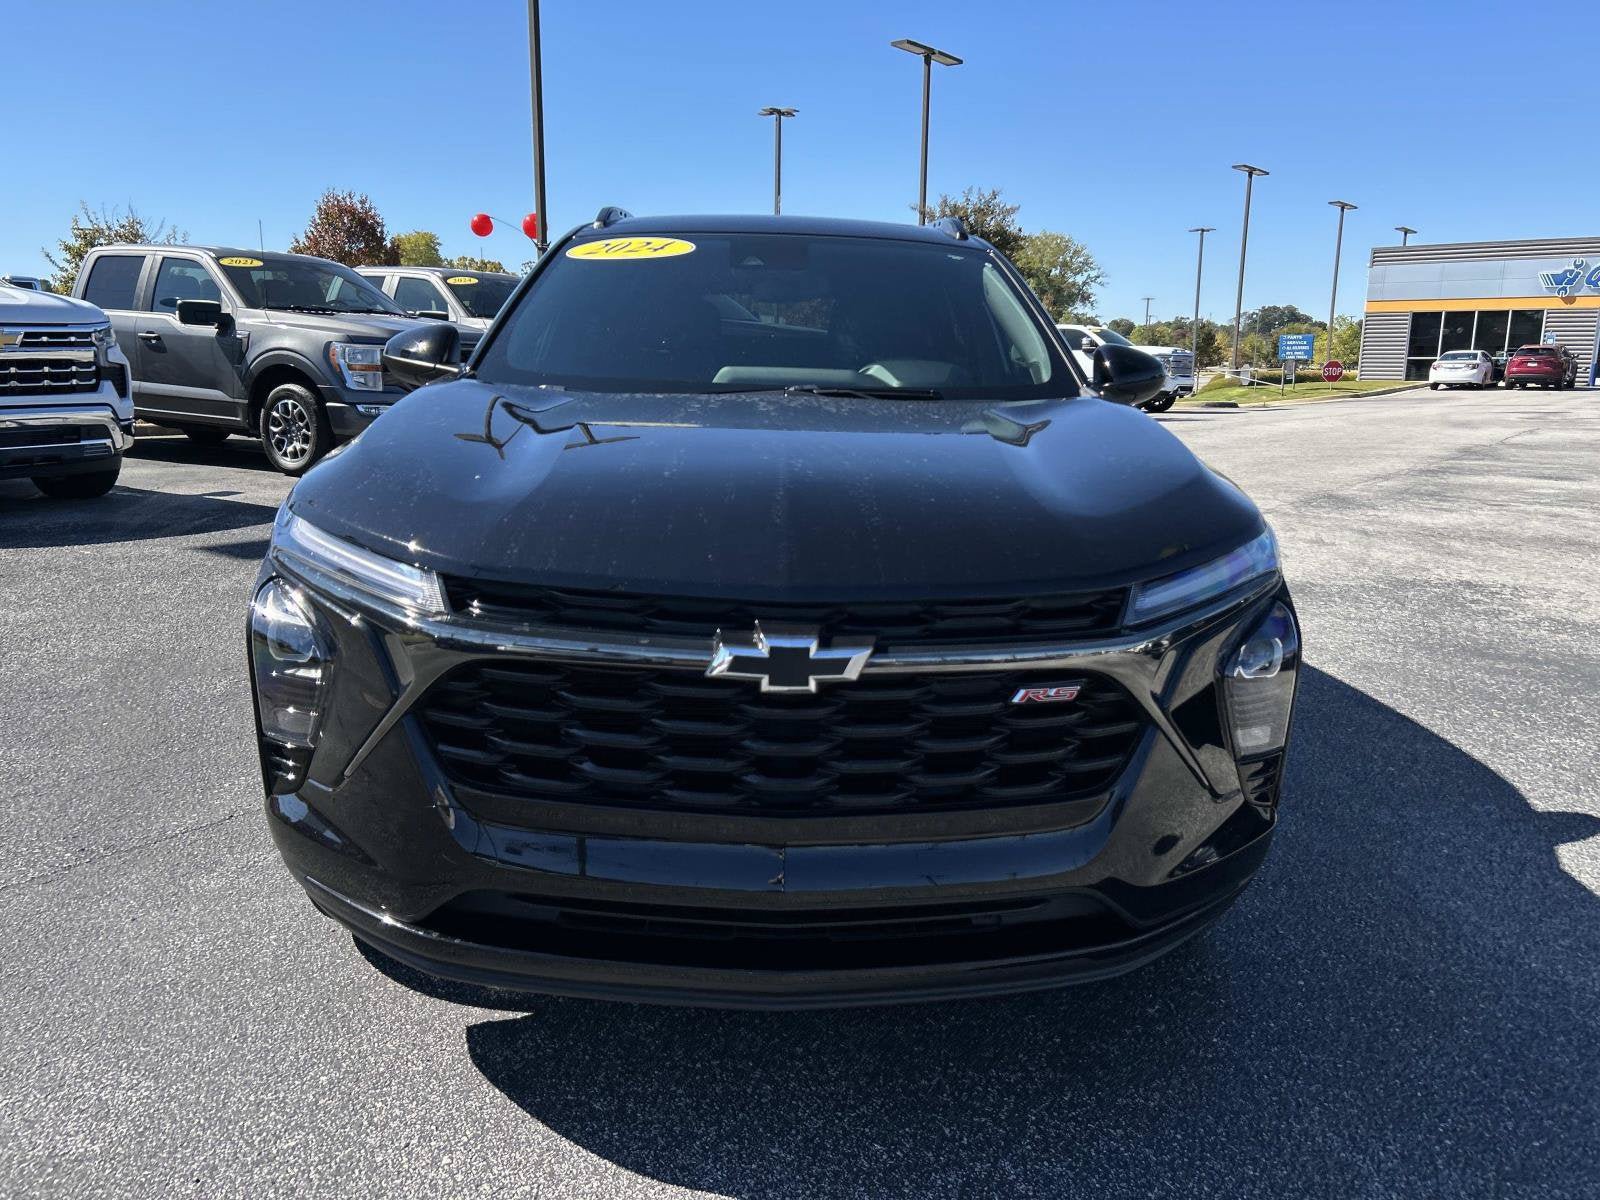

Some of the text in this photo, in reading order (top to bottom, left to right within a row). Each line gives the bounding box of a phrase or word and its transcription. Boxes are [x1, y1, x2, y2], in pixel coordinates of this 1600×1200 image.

[582, 241, 676, 255] 2024
[1324, 367, 1342, 376] STOP
[1012, 686, 1080, 703] RS
